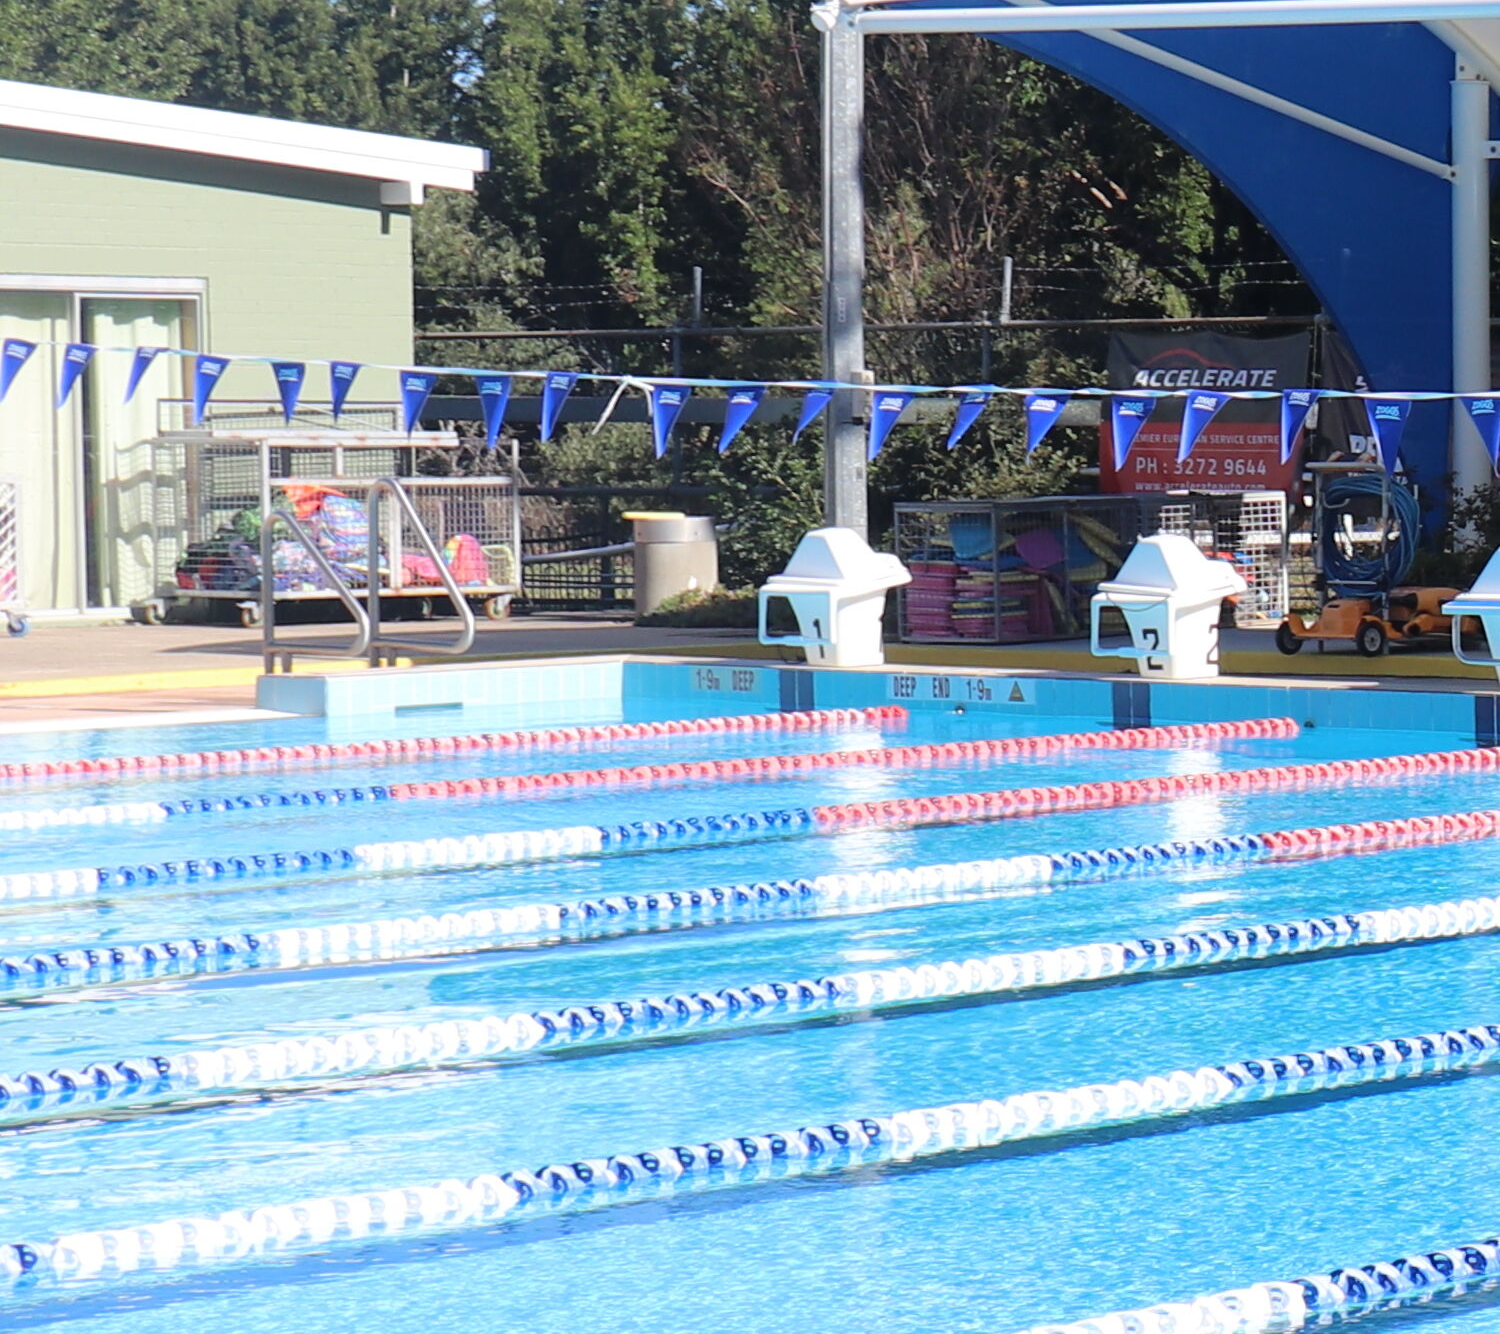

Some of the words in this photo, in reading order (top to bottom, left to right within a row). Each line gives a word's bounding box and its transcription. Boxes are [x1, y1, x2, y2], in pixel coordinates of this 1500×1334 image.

[1133, 370, 1277, 388] ACCELERATE
[1210, 435, 1244, 444] SERVICE
[1247, 435, 1280, 445] CENTRE
[1136, 457, 1158, 474] PH
[1174, 458, 1217, 475] 3272
[1224, 459, 1267, 476] 9644
[813, 618, 825, 659] 1
[1142, 628, 1164, 670] 2
[732, 670, 755, 692] DEEP
[893, 676, 917, 698] DEEP
[933, 677, 950, 699] END
